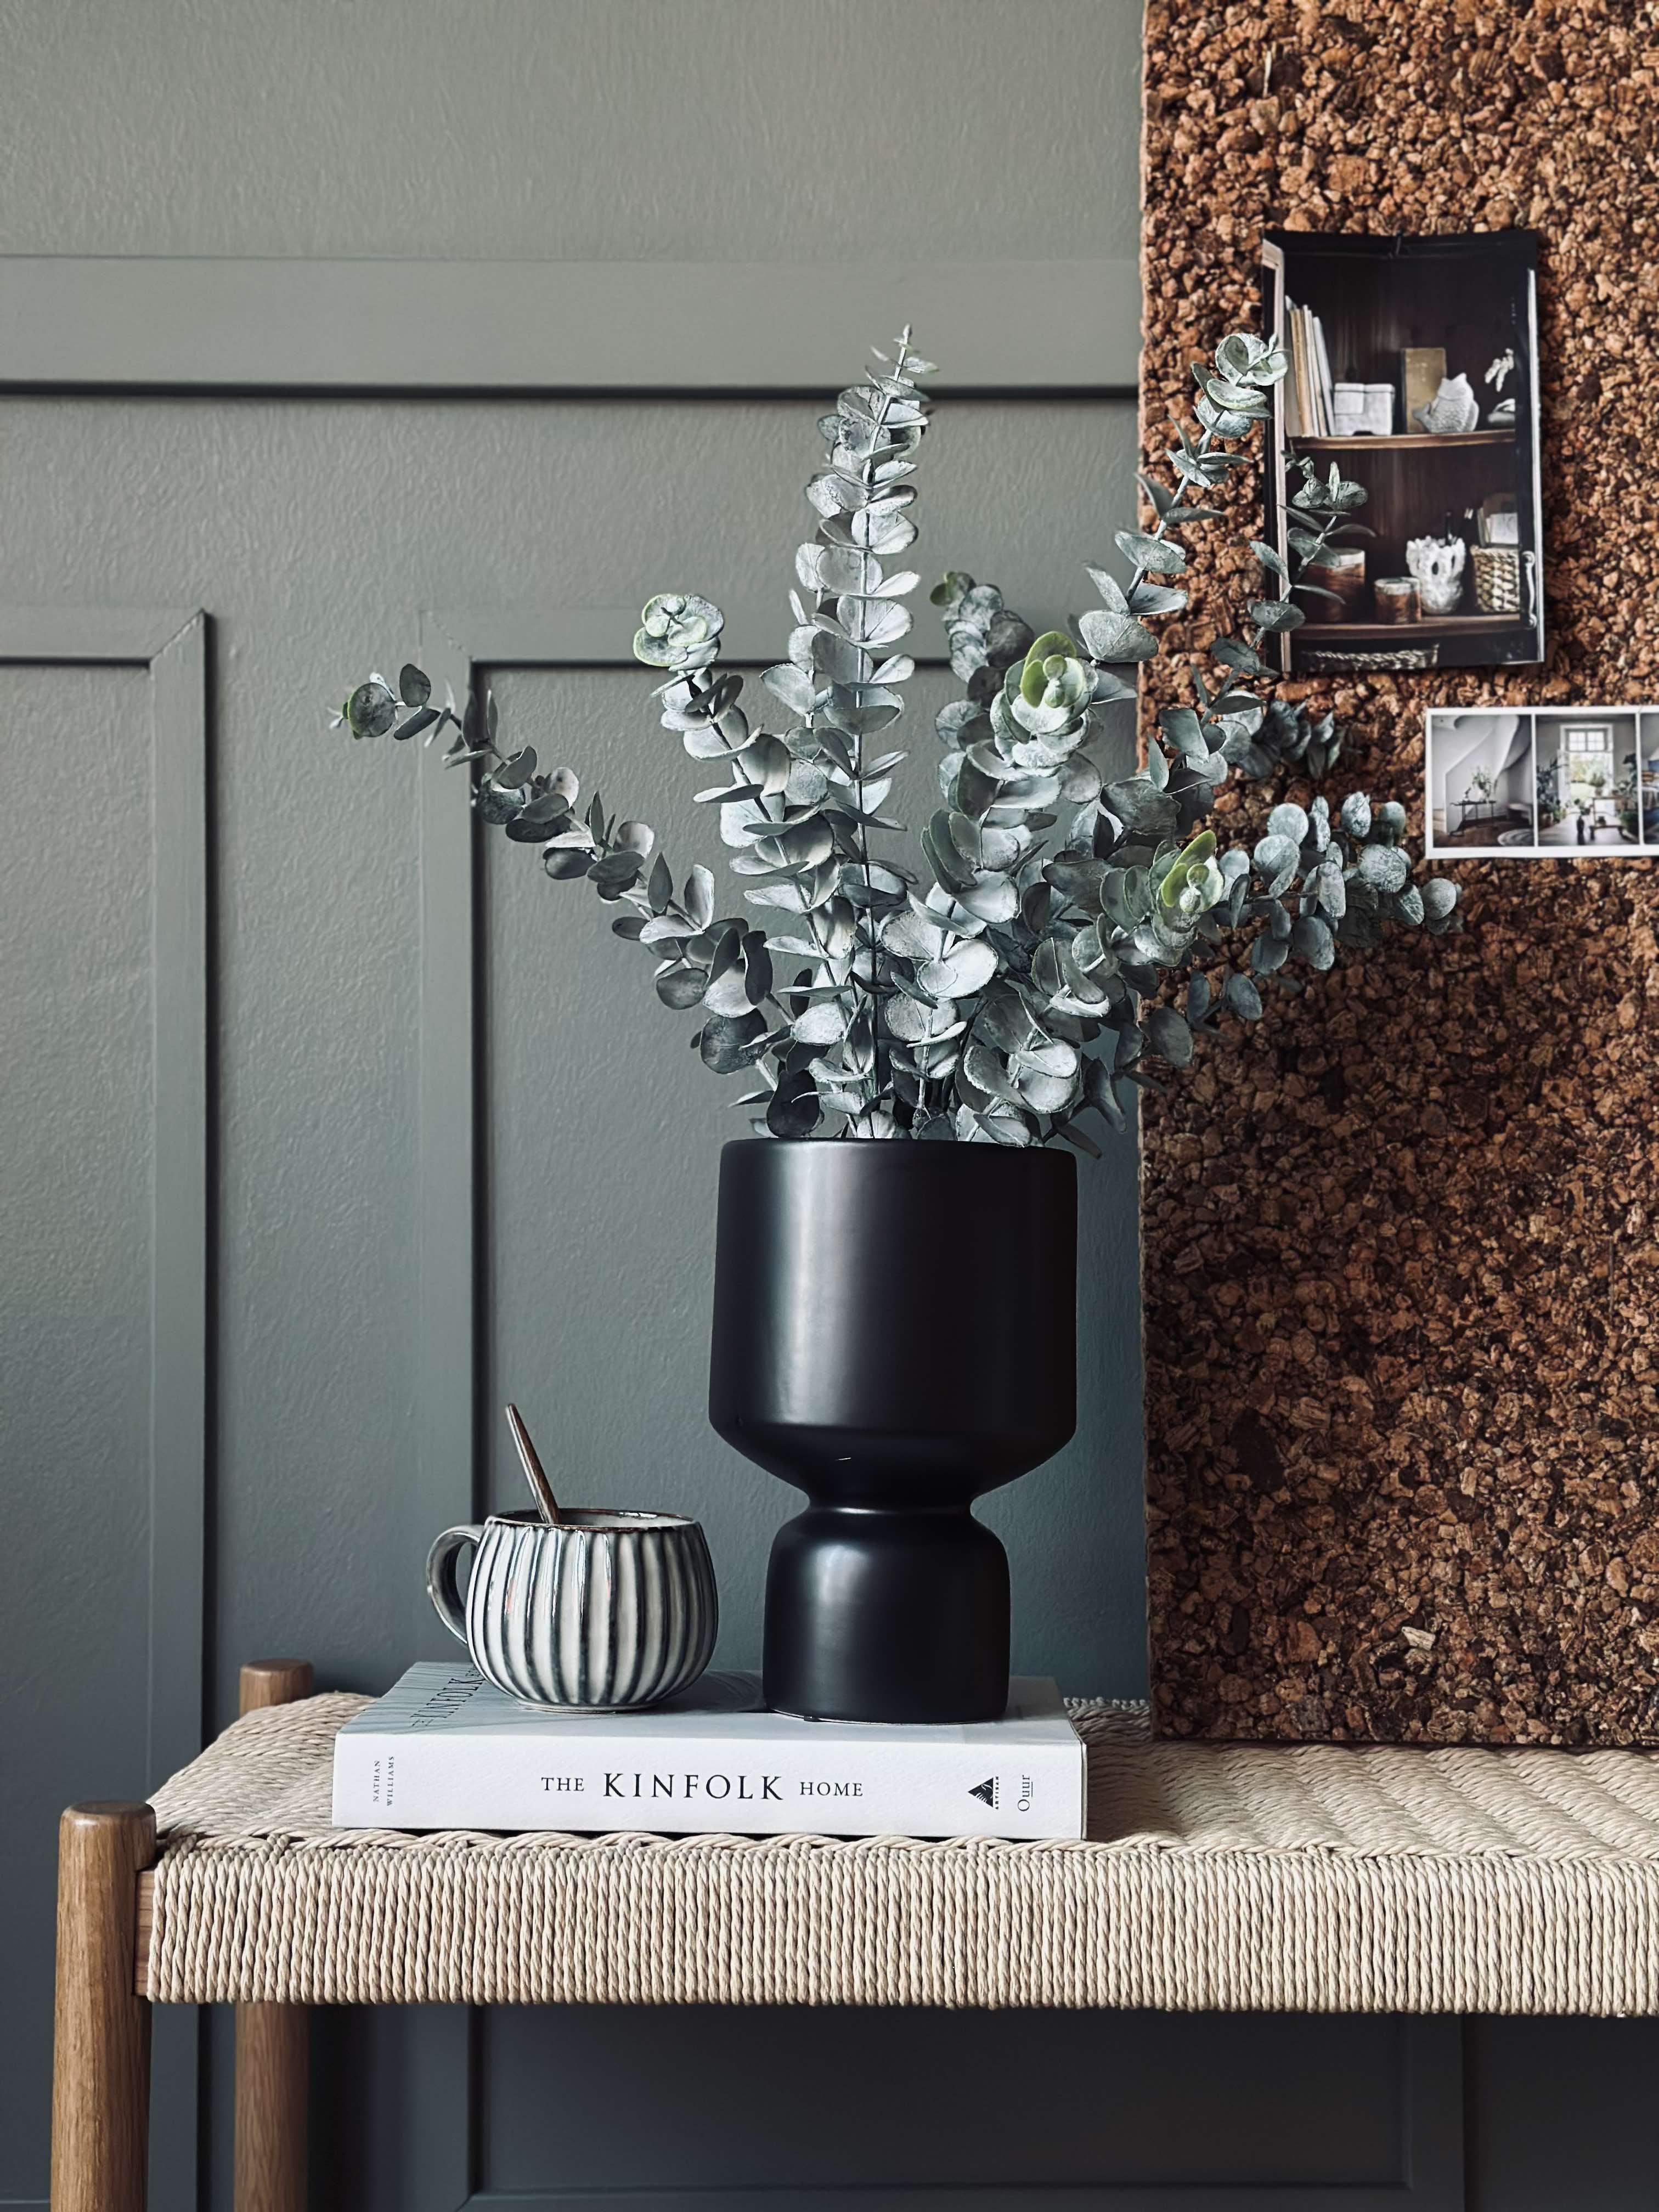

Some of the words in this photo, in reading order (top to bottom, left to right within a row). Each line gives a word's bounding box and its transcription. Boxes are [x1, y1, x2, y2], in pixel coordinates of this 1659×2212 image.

[410, 1678, 486, 1718] KINFOLK
[541, 1777, 584, 1791] THE
[603, 1773, 783, 1800] KINFOLK
[800, 1782, 863, 1797] HOME
[1018, 1775, 1030, 1812] Ouur
